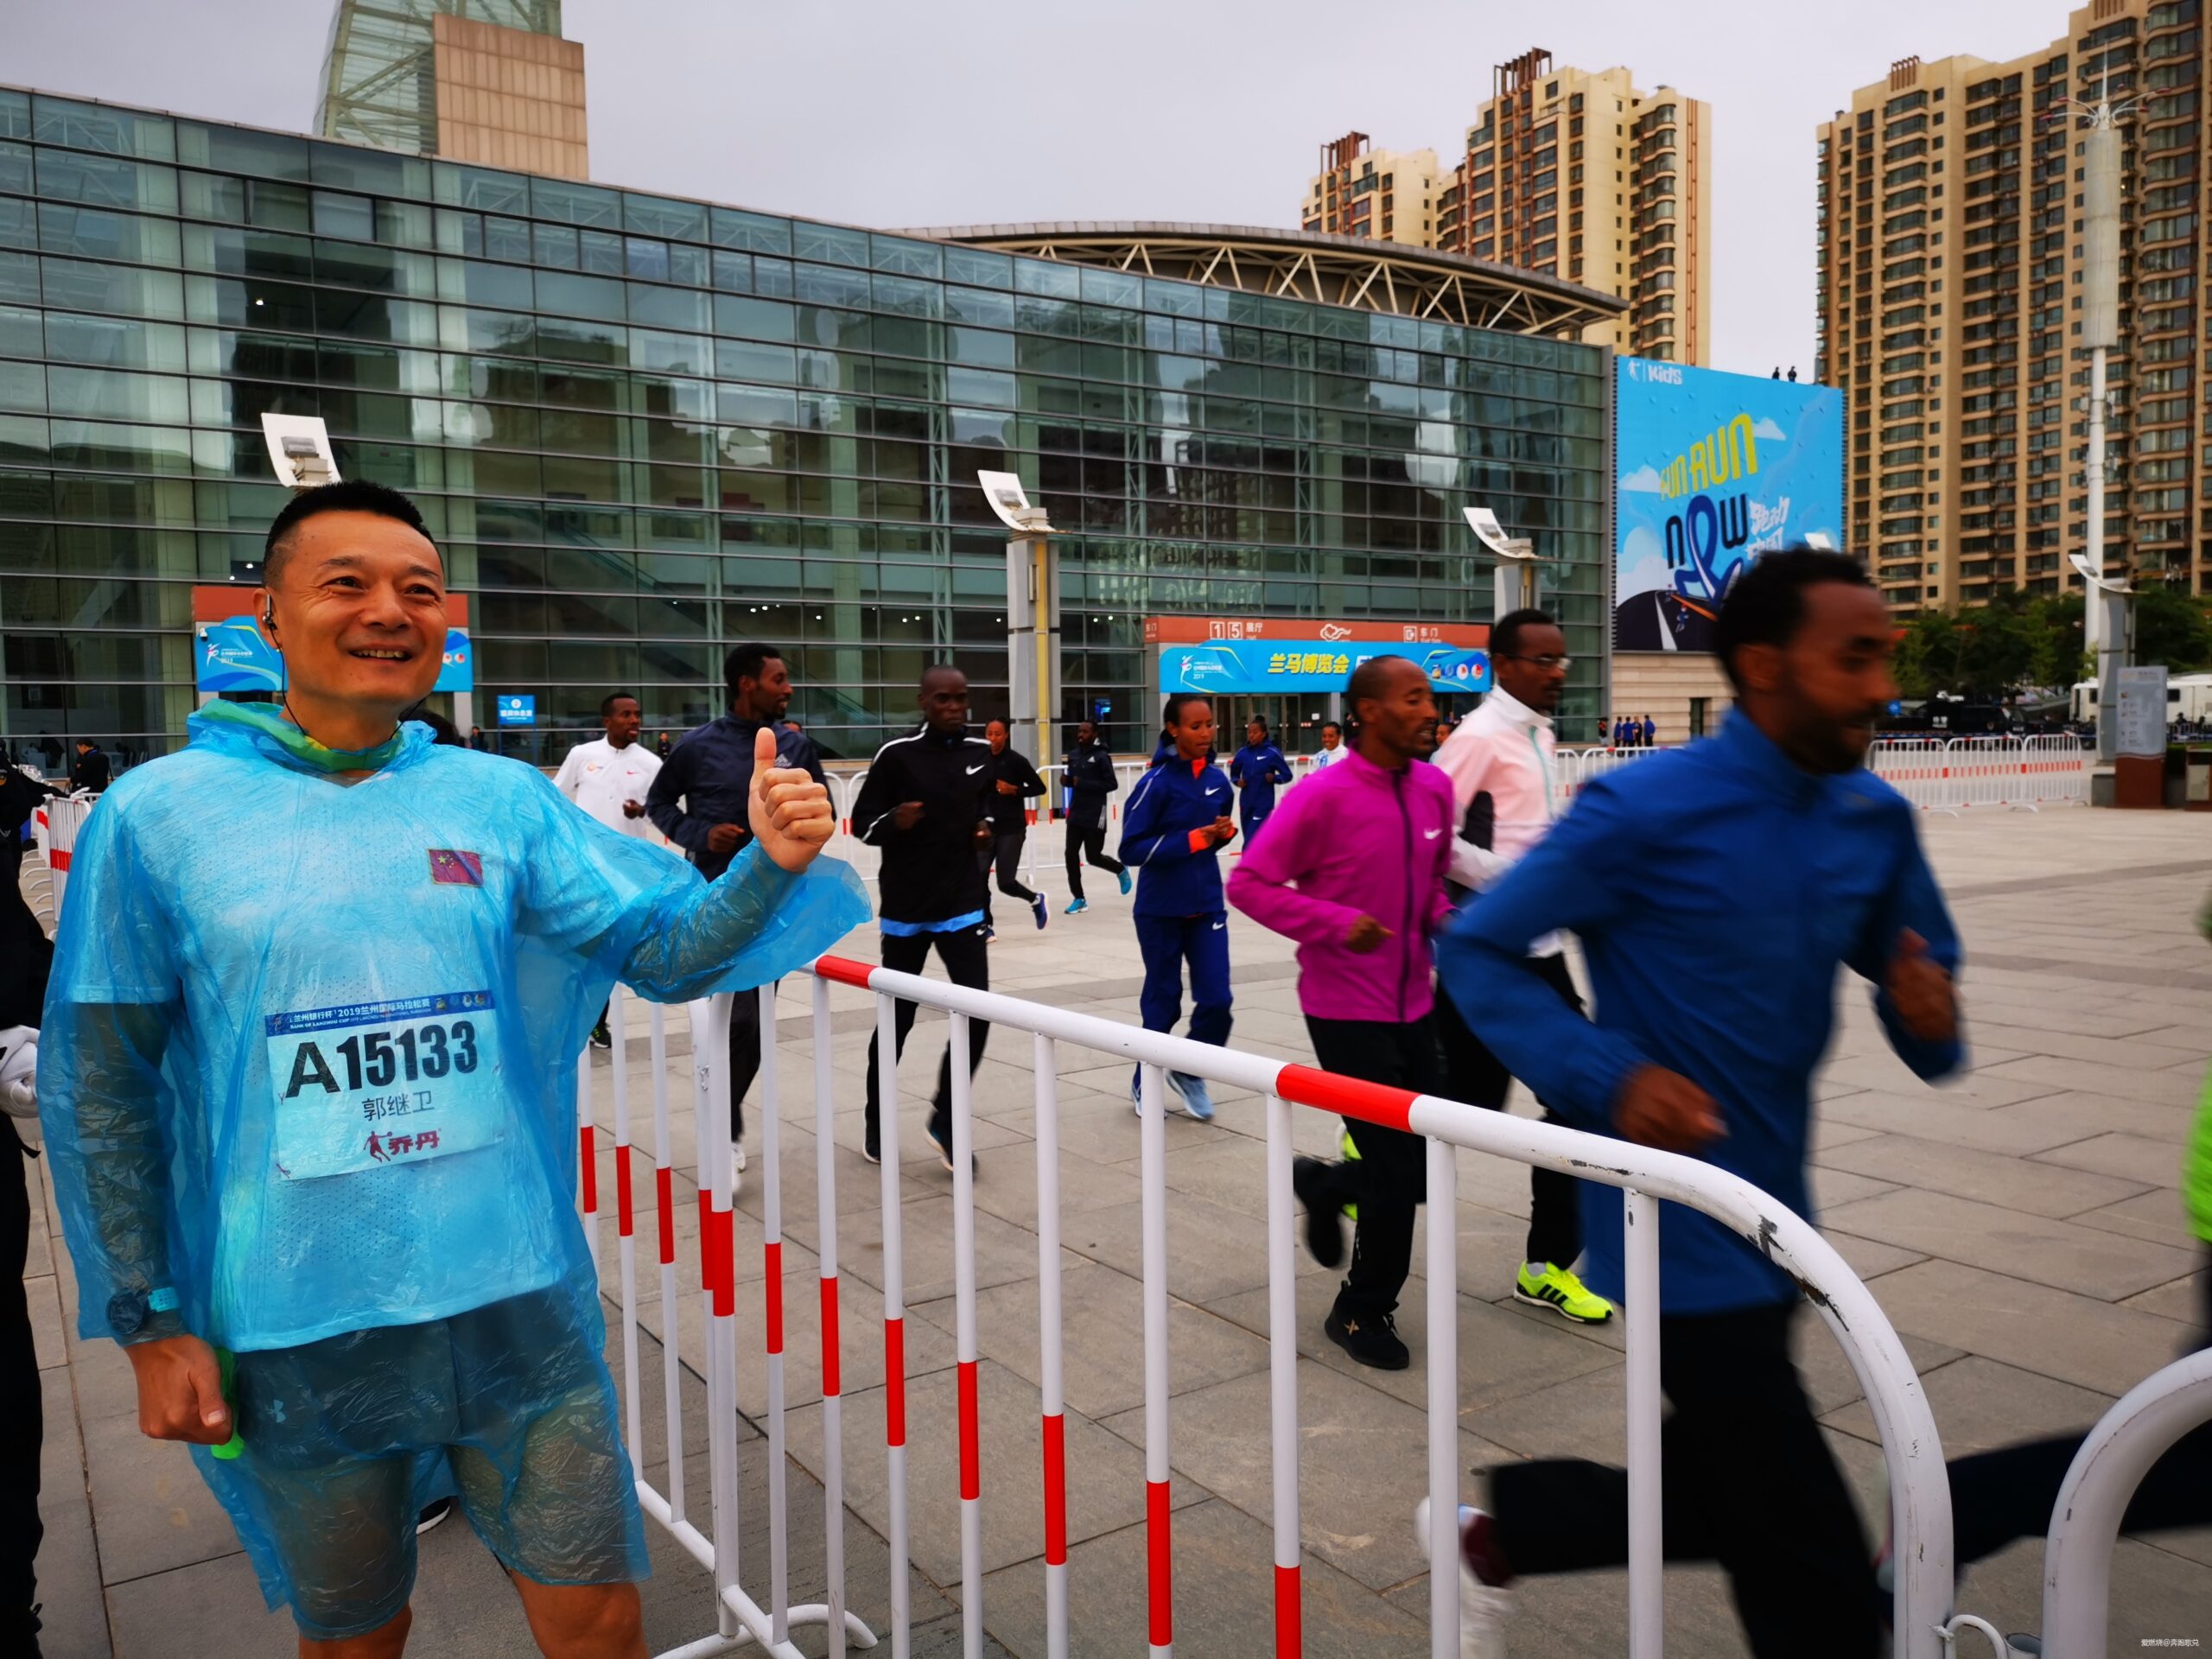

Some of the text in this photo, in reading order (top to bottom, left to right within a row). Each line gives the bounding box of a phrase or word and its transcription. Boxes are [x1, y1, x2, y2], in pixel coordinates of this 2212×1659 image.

[1648, 364, 1682, 385] Kids
[1690, 414, 1758, 493] RUN
[1267, 653, 1351, 674] 兰马博览会
[285, 1020, 478, 1098] A15133
[361, 1090, 435, 1122] 郭继卫
[388, 1130, 439, 1154] 乔丹
